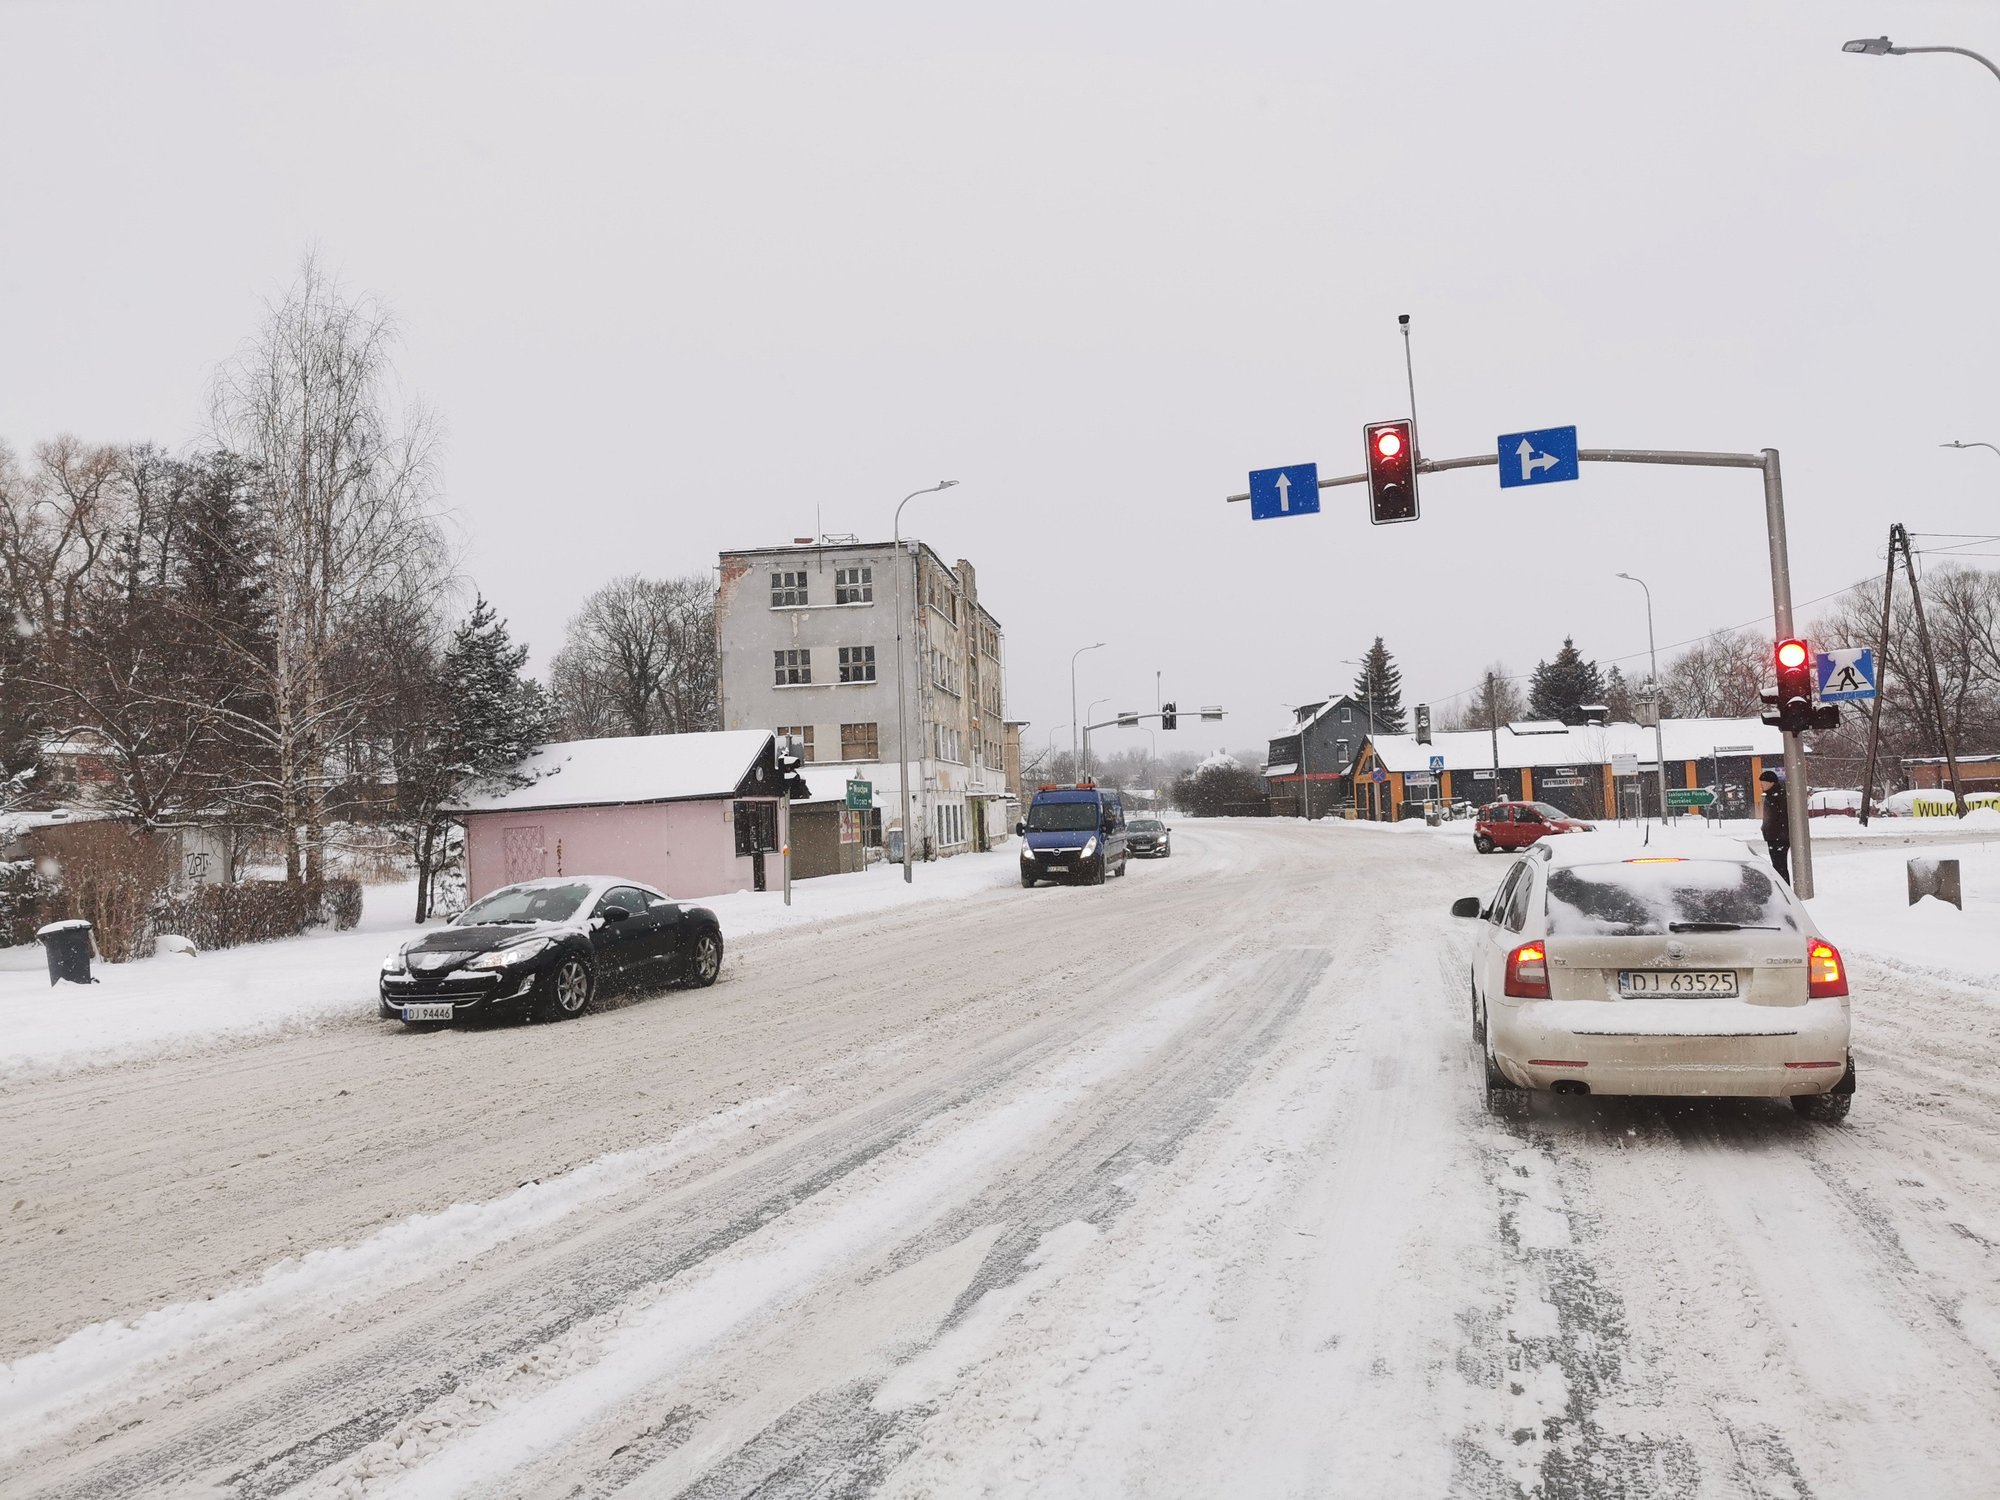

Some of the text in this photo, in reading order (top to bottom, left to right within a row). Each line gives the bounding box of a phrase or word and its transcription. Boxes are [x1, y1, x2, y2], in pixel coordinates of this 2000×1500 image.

[1632, 974, 1733, 992] DJ 63525
[409, 1008, 450, 1019] DJ 94446
